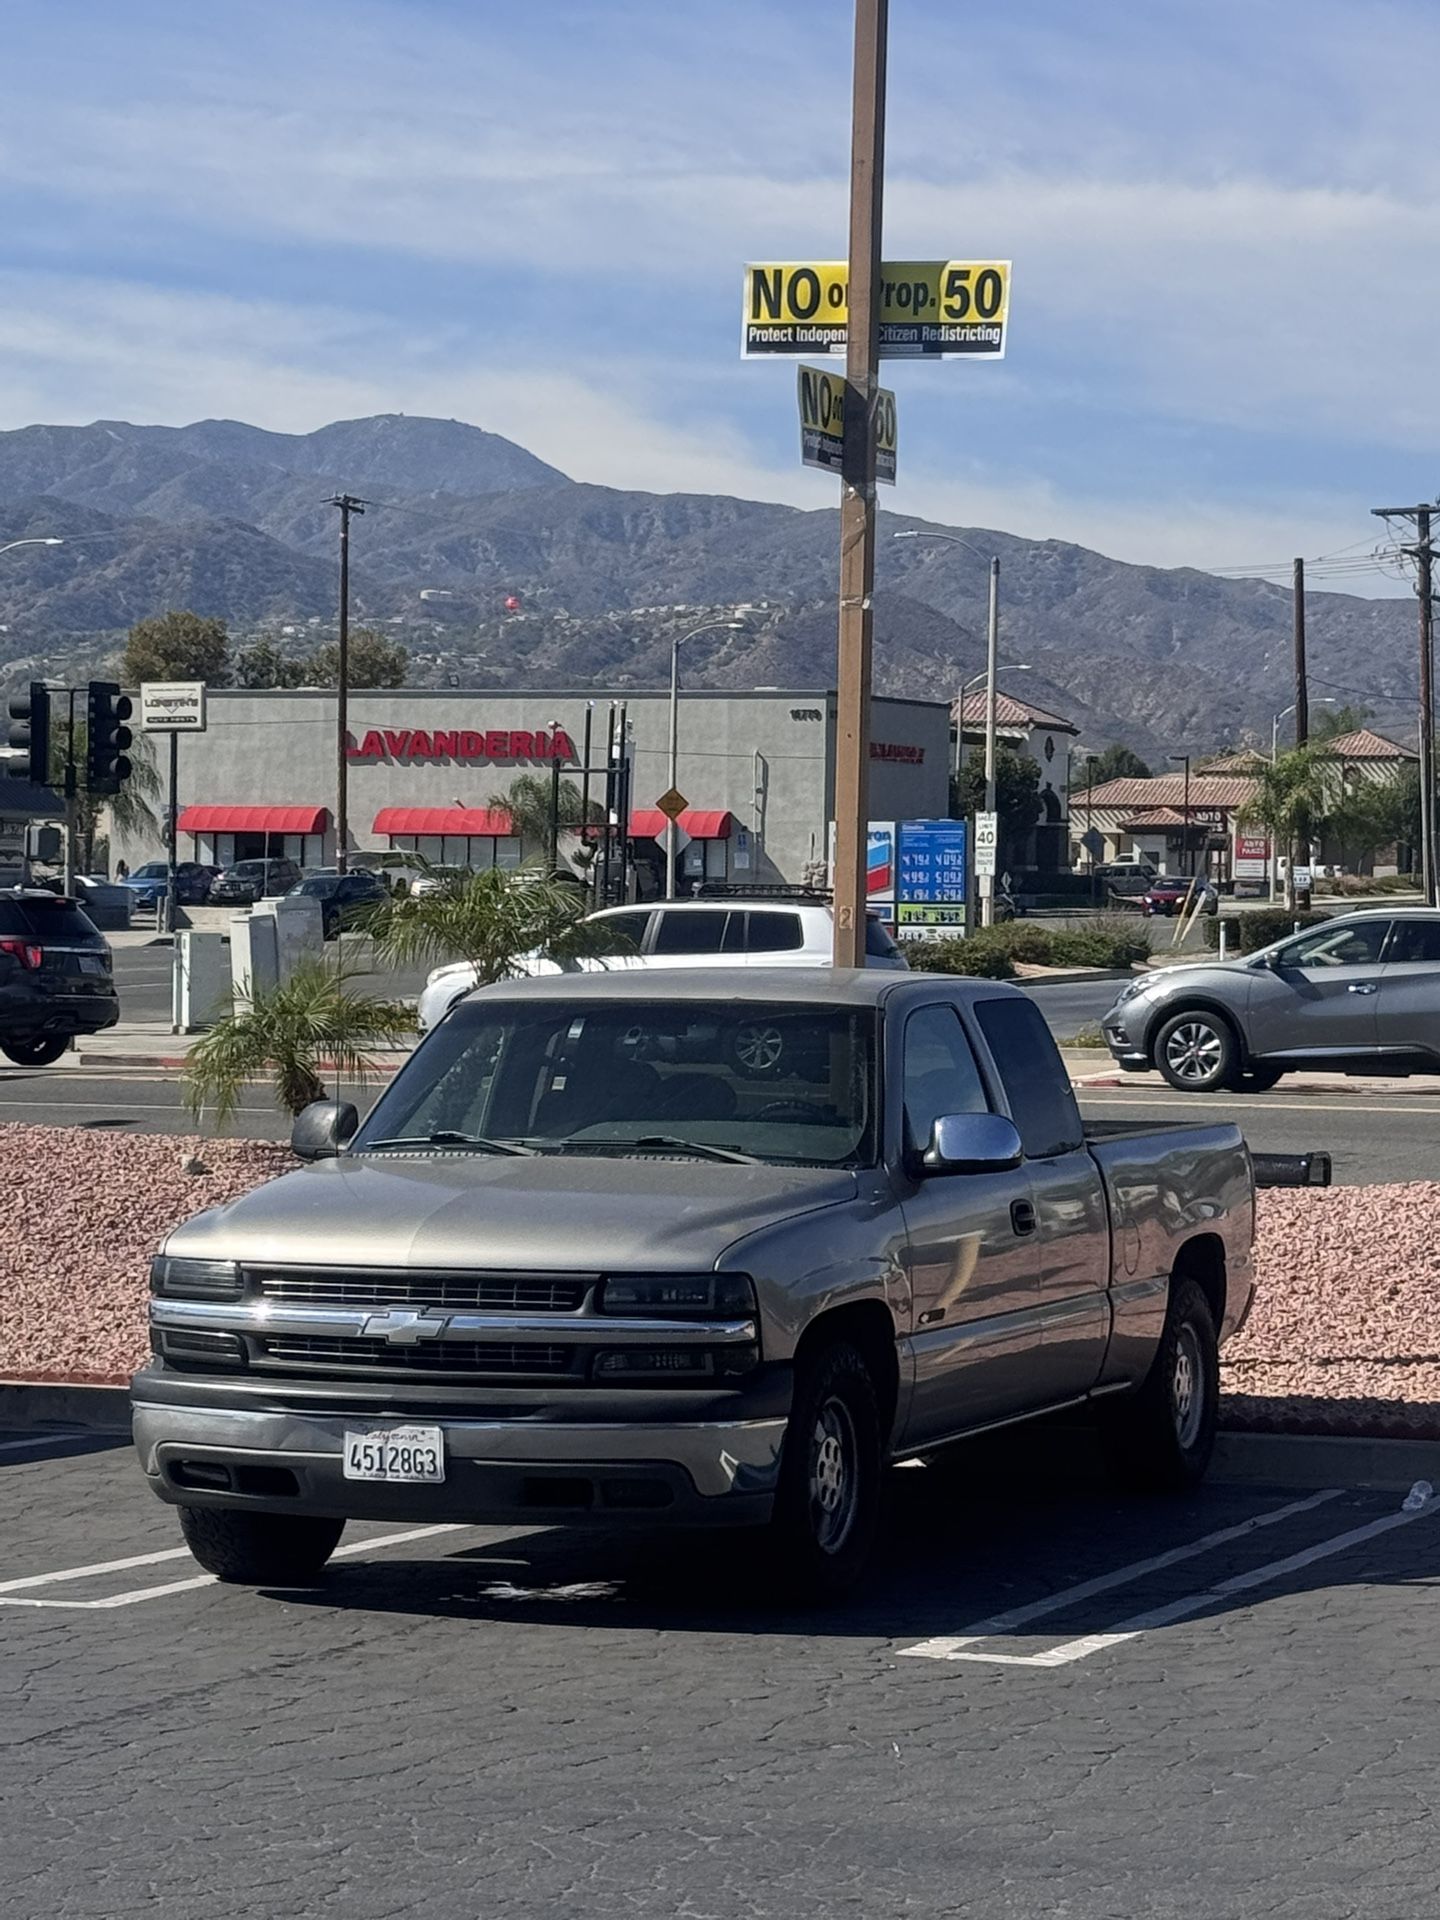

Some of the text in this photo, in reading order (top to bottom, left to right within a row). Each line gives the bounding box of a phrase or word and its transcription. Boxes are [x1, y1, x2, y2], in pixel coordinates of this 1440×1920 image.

[752, 268, 821, 320] NO
[828, 283, 848, 308] o
[944, 269, 1003, 319] 50
[749, 325, 1001, 345] Protect Indepen Citizen Redistricting
[802, 371, 832, 429] NO
[1196, 811, 1221, 821] AUTO
[977, 831, 995, 844] 40
[841, 908, 851, 927] 2
[350, 1444, 438, 1474] 45128G3
